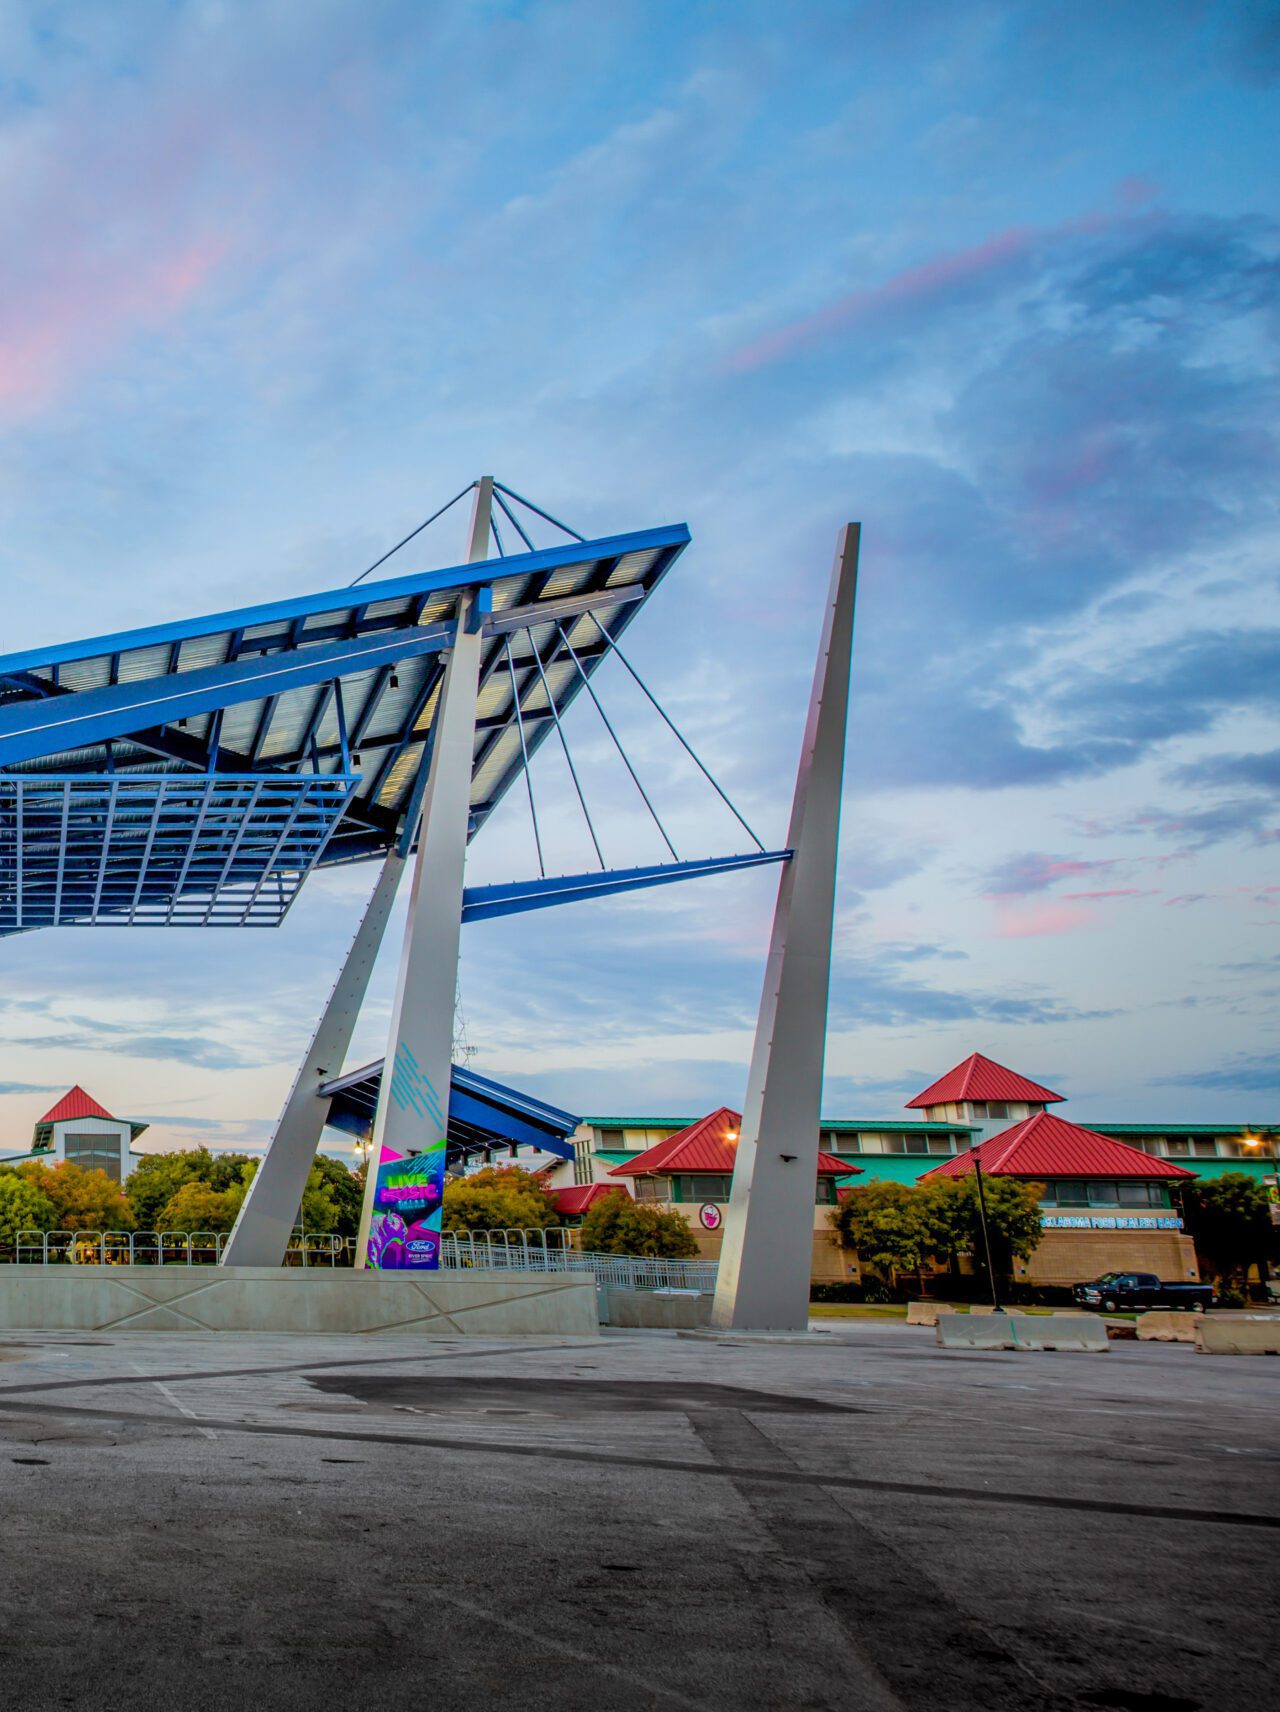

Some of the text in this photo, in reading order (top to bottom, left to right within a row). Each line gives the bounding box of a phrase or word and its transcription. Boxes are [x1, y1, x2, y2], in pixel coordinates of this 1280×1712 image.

[387, 1173, 427, 1188] LIVE
[381, 1184, 437, 1202] MUSIC
[1040, 1216, 1091, 1228] OKLAHOMA
[1092, 1216, 1116, 1229] FORD
[1116, 1217, 1157, 1229] DEALERS
[410, 1241, 430, 1250] Ford
